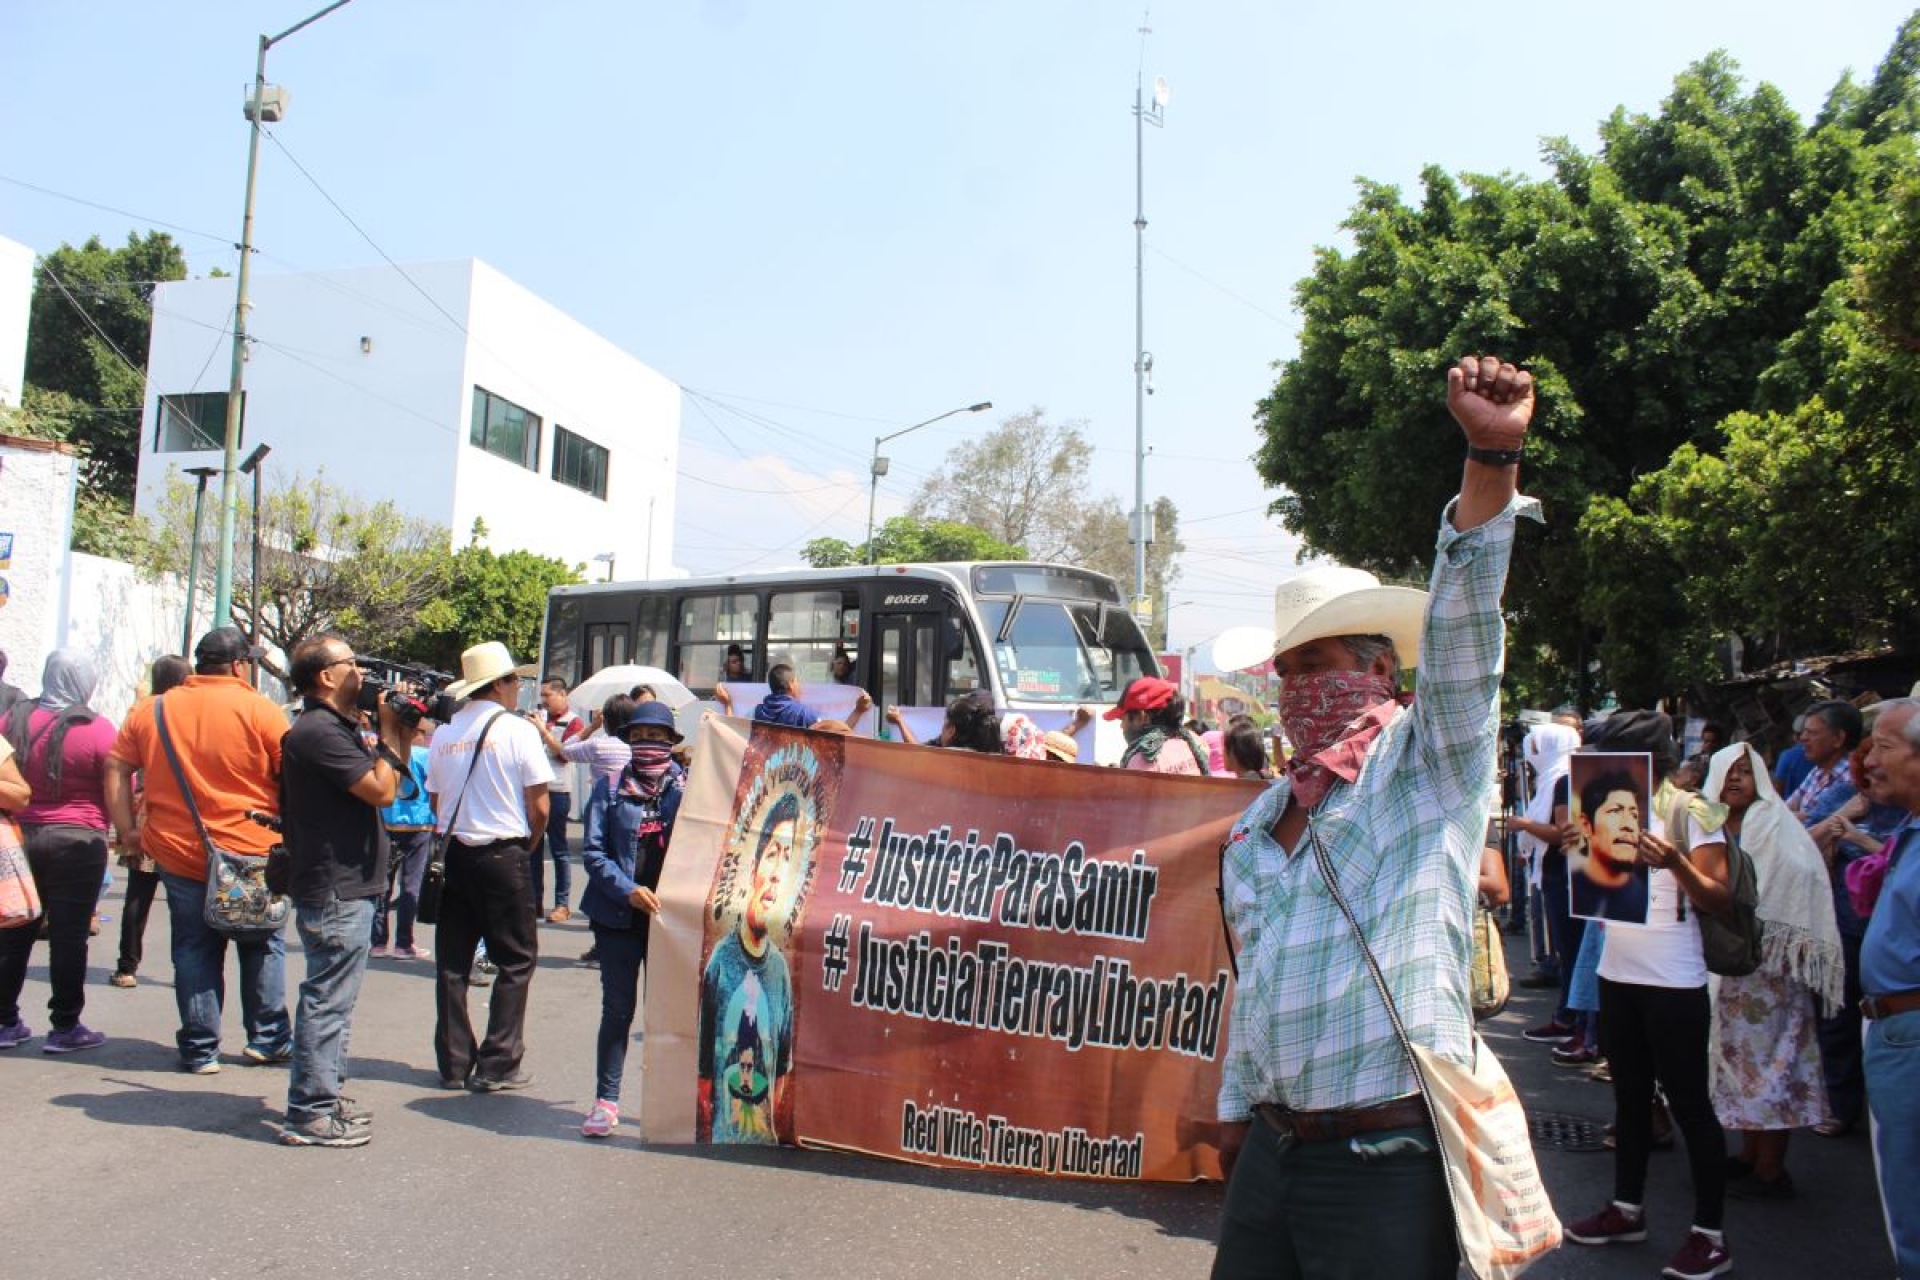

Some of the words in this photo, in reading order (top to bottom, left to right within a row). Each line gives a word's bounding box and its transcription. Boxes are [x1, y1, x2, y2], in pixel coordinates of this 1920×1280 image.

[884, 594, 929, 605] BOXER
[837, 816, 1158, 943] #JusticiaParaSamir
[901, 1100, 941, 1155] Red
[1044, 1132, 1061, 1174] y
[1060, 1126, 1144, 1179] Libertad
